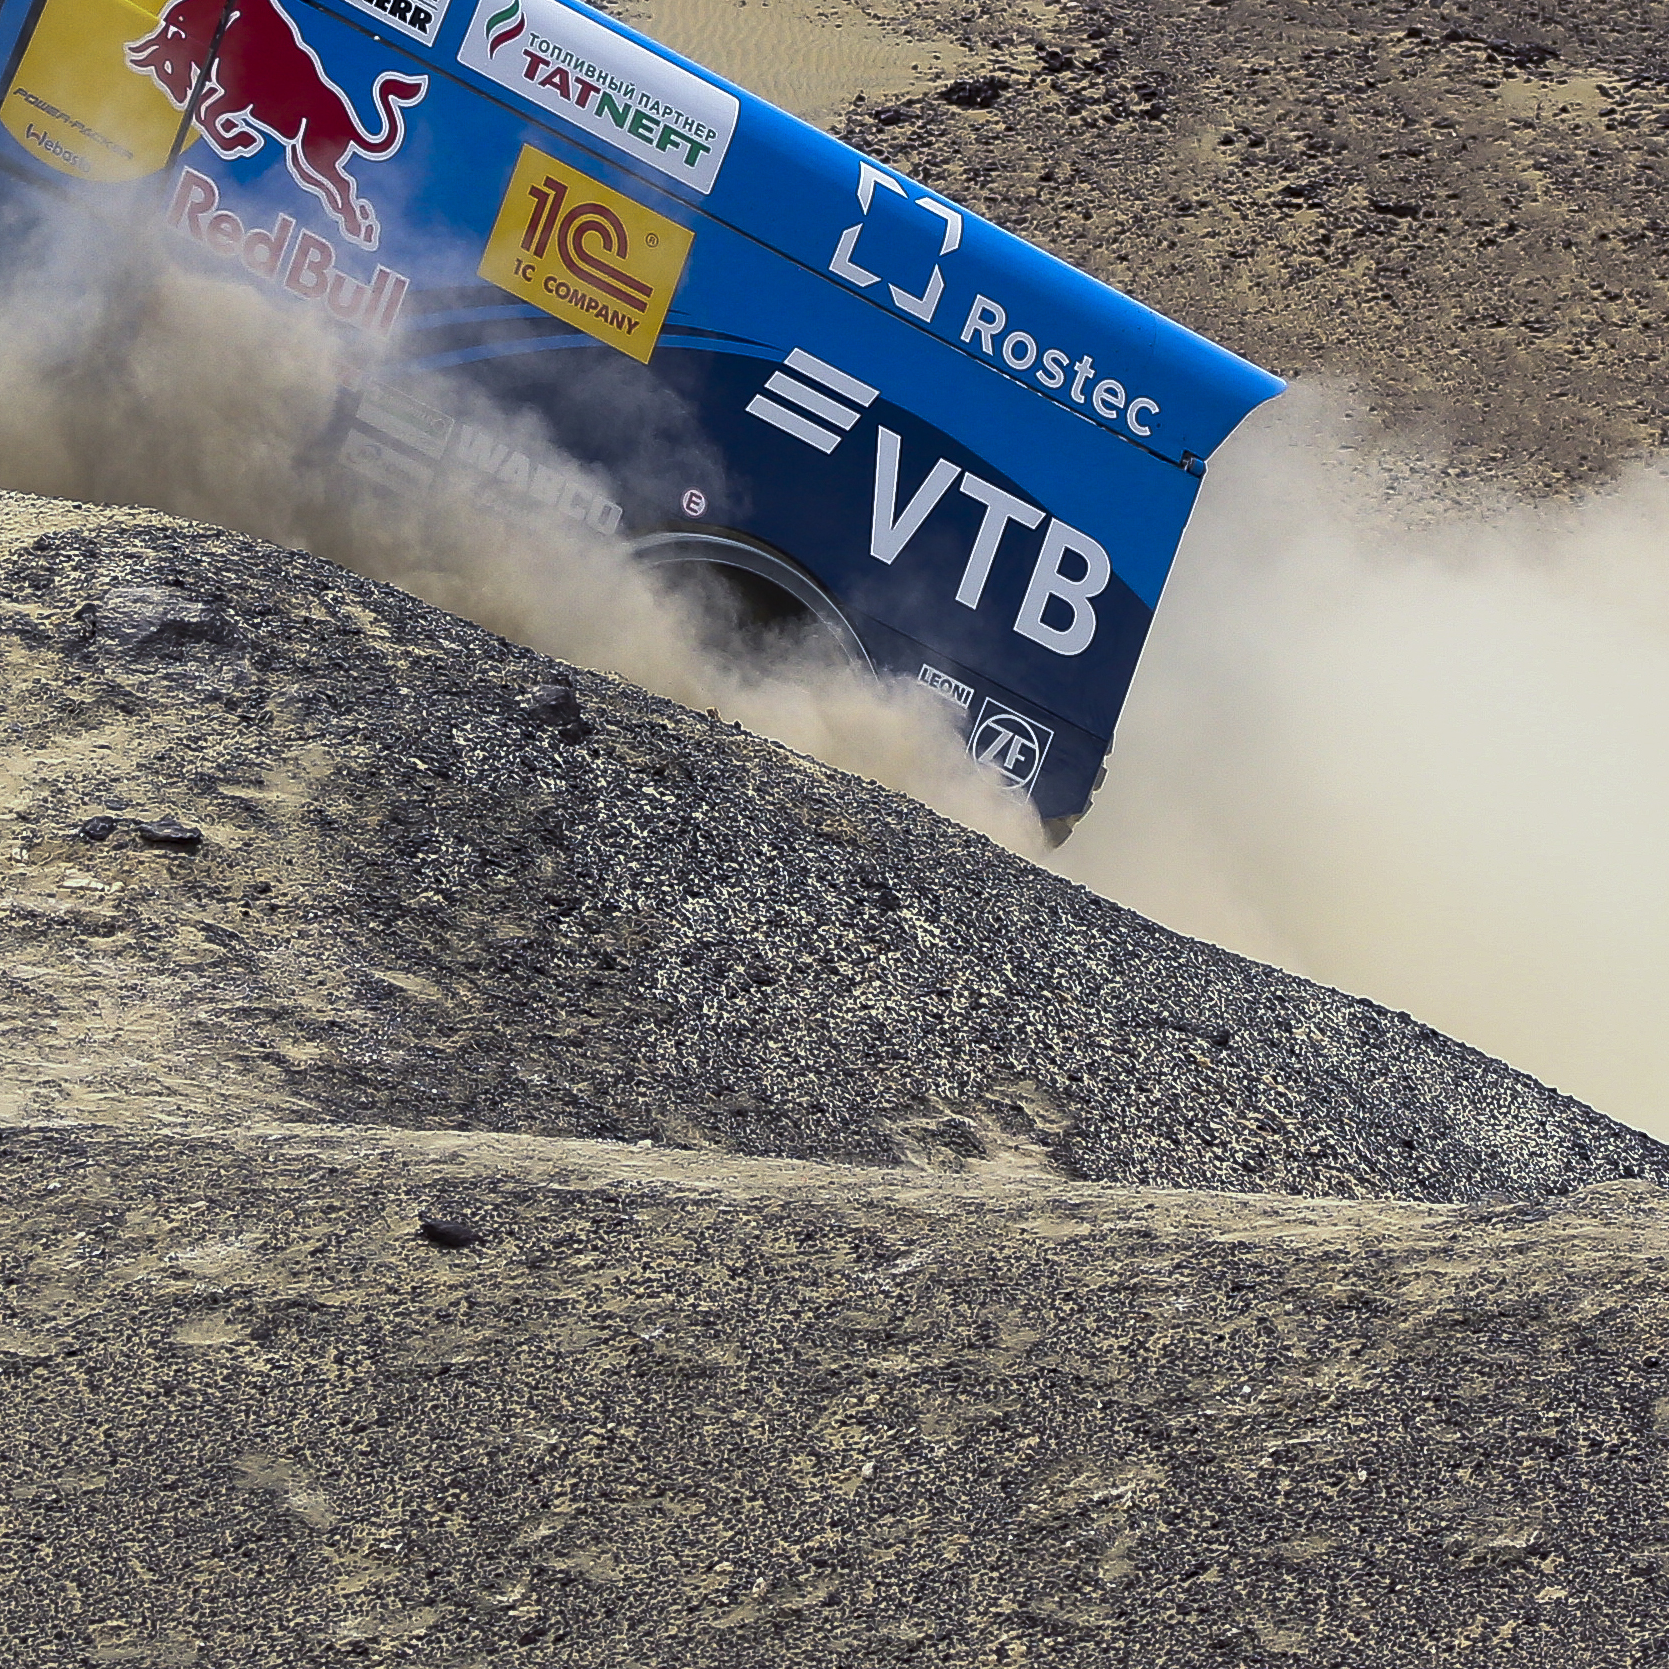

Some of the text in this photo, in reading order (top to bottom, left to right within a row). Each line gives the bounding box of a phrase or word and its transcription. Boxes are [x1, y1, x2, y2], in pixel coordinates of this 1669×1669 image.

[522, 49, 712, 168] TATNEFT
[529, 32, 717, 142] ТОПЛИВНЫЙ ПАРТНЕР
[168, 166, 411, 334] Red Bull
[514, 258, 640, 336] 1C COMPANY
[960, 293, 1160, 436] Rostec
[461, 423, 624, 535] WABCO
[870, 424, 1112, 656] VTB
[921, 667, 972, 708] LEONI
[977, 721, 1038, 784] ZF
